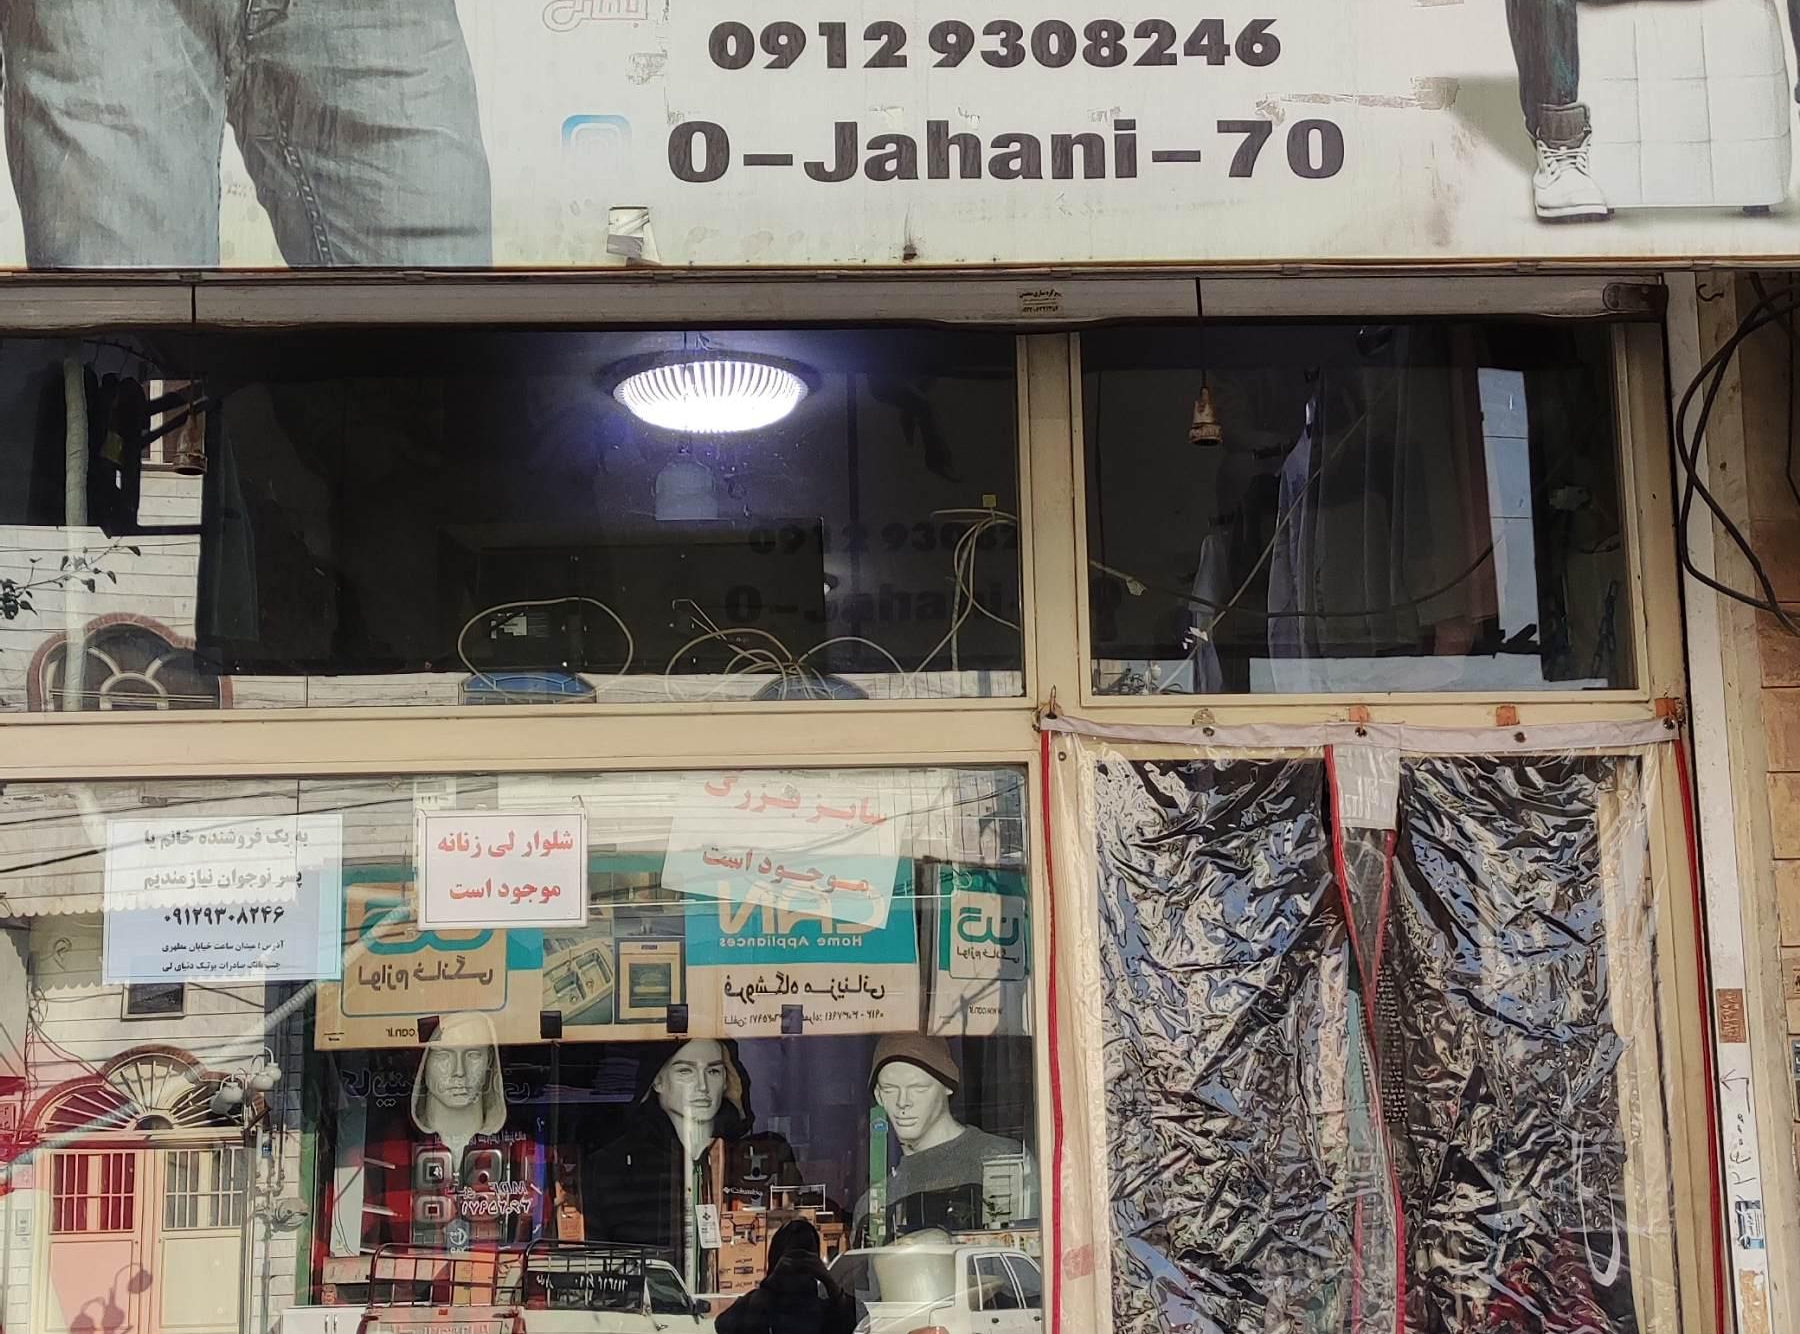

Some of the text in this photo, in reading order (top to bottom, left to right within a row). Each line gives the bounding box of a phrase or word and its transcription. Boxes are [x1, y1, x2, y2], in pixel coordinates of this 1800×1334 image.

[708, 17, 1283, 70] 0912 9308246
[160, 830, 194, 850] خانم
[199, 828, 262, 849] فروشنده
[438, 830, 573, 859] شلوار لی زنانه
[217, 868, 272, 889] نوجوان
[702, 847, 868, 893] موجود است
[449, 878, 561, 905] موجود است
[164, 905, 285, 926] ۰۹۱۲۹۳۰۸۲۴۶
